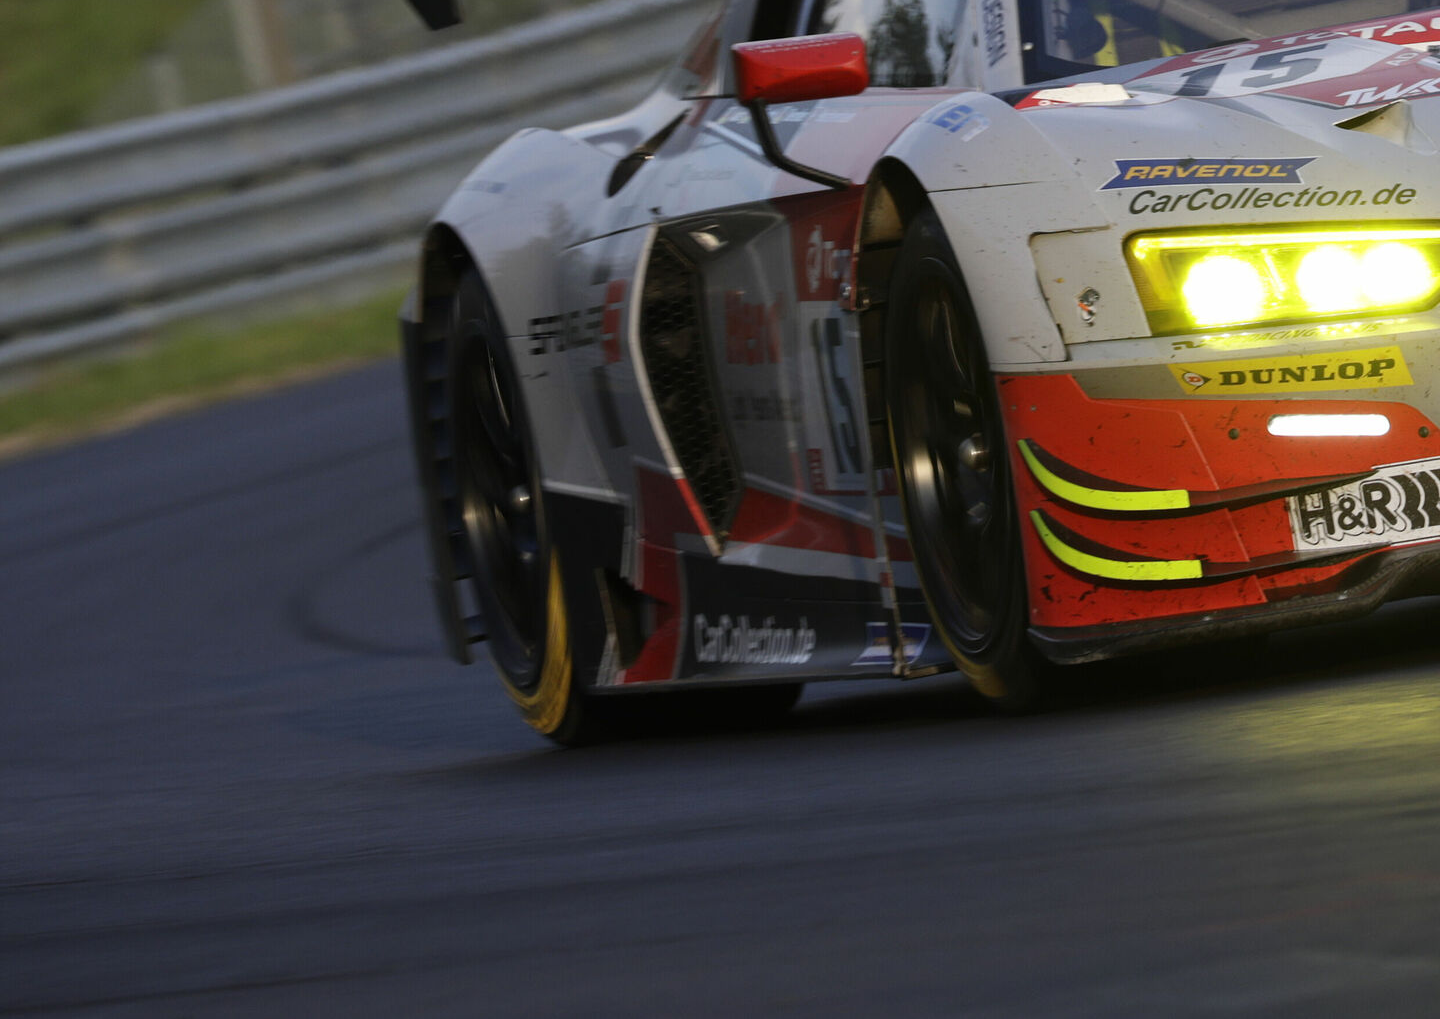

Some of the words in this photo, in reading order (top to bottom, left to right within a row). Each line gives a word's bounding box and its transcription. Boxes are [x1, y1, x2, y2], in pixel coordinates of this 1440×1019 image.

[1175, 42, 1330, 97] 15
[1123, 163, 1291, 180] RAVENOL
[1128, 183, 1417, 214] CarCollection.de
[1218, 358, 1396, 386] DUNLOP
[1298, 482, 1399, 539] H&R
